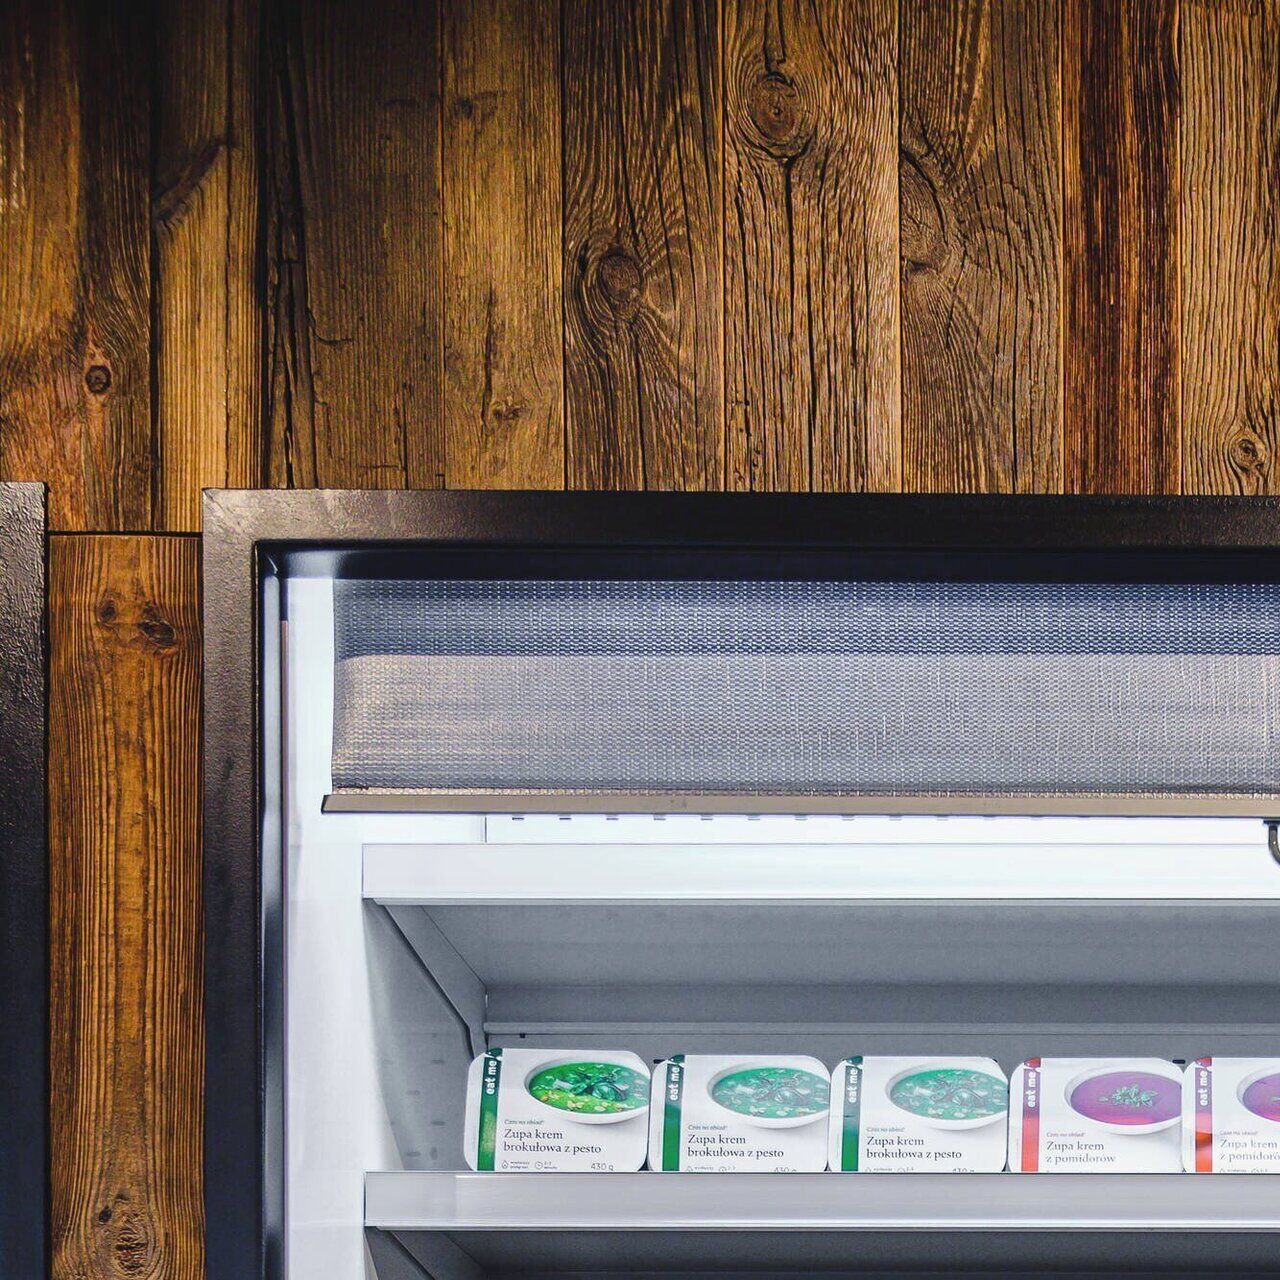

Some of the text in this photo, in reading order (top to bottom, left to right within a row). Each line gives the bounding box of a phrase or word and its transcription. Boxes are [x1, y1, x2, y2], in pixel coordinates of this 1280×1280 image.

[485, 1060, 497, 1095] eat me
[668, 1066, 680, 1101] eat me
[848, 1068, 858, 1103] eat me
[1026, 1071, 1036, 1108] eat me
[1198, 1070, 1208, 1106] eat me
[504, 1128, 563, 1141] Zupa krem
[688, 1134, 746, 1146] Zupa krem
[503, 1141, 562, 1152] brokułowa
[572, 1145, 602, 1155] pesto
[866, 1136, 925, 1148] Zupa krem
[1046, 1140, 1105, 1153] Zupa krem
[1220, 1138, 1278, 1150] Zupa krem
[687, 1147, 745, 1157] brokułowa
[756, 1150, 784, 1160] pesto
[866, 1149, 923, 1159] brokułowa
[934, 1152, 962, 1162] pesto
[1054, 1153, 1116, 1166] pomidorów
